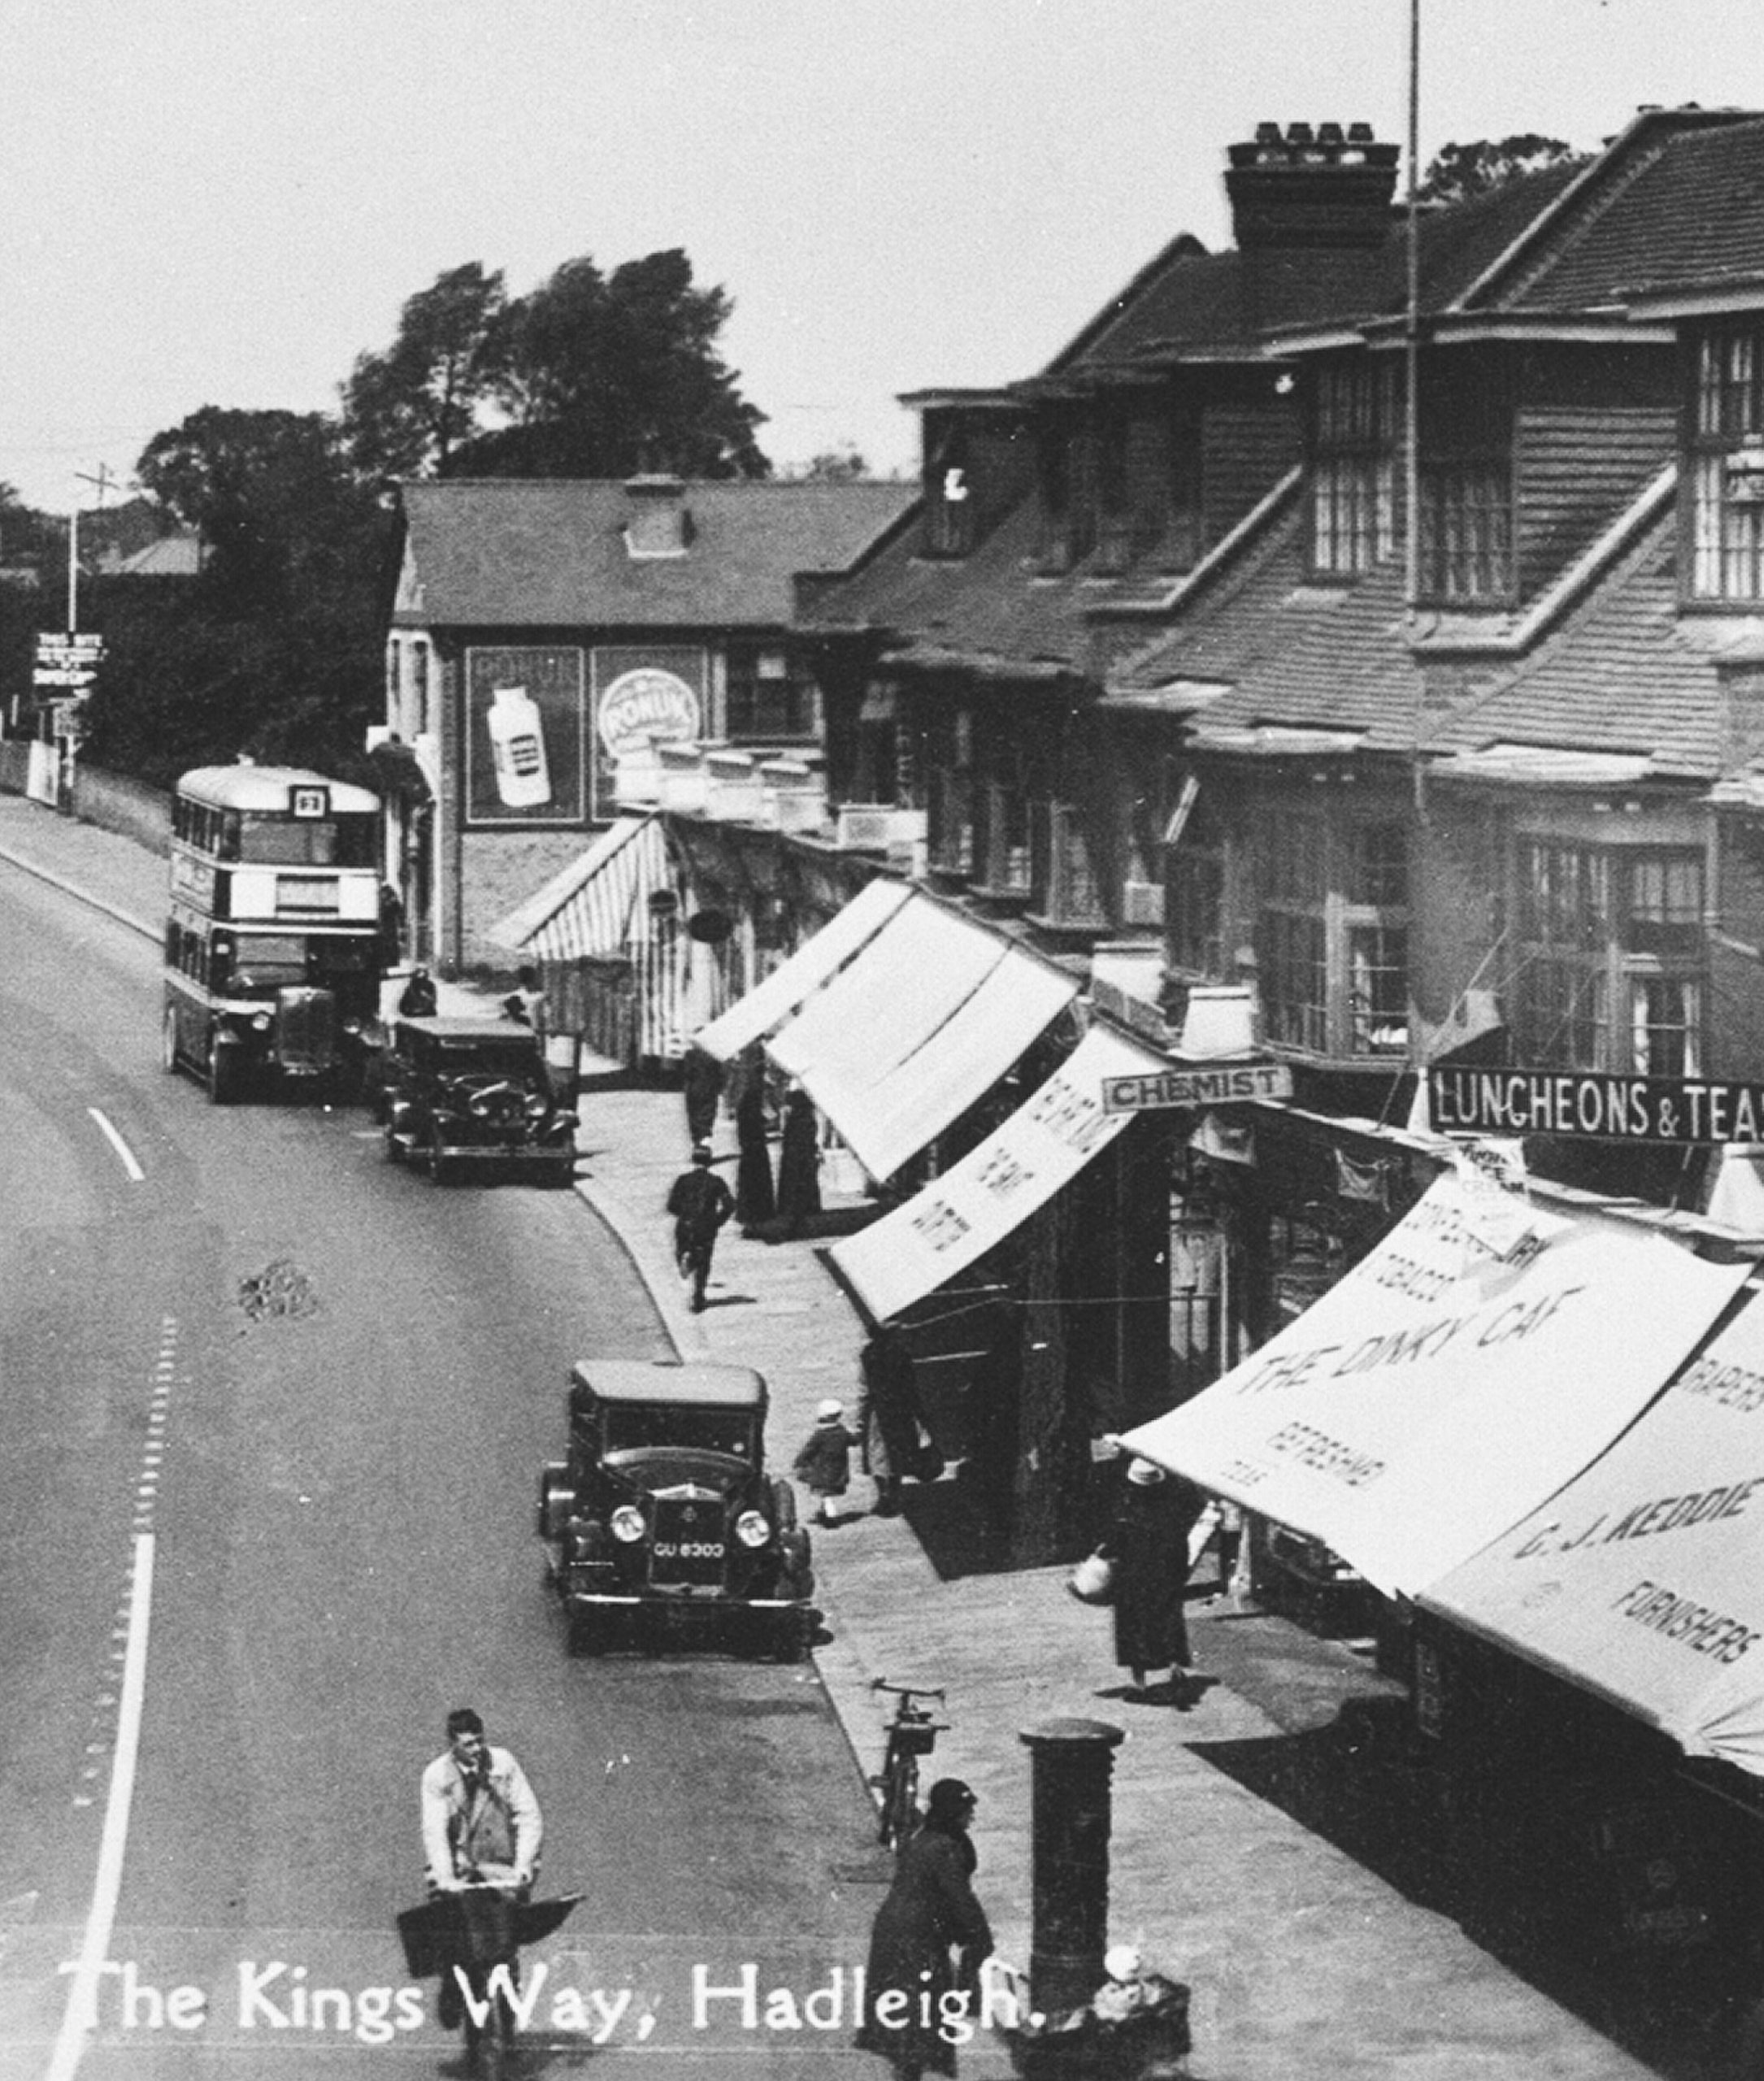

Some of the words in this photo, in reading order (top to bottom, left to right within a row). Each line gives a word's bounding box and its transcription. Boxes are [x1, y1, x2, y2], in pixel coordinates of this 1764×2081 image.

[1111, 1068, 1279, 1106] CHEMIST
[1435, 1071, 1649, 1136] LUNCHEONS
[1658, 1097, 1680, 1137] &
[1683, 1085, 1764, 1141] TEA
[1236, 1344, 1343, 1395] THE
[1331, 1312, 1479, 1379] DINKY
[1602, 1476, 1764, 1543] KEDDIE
[1610, 1579, 1762, 1663] FURNISHERS
